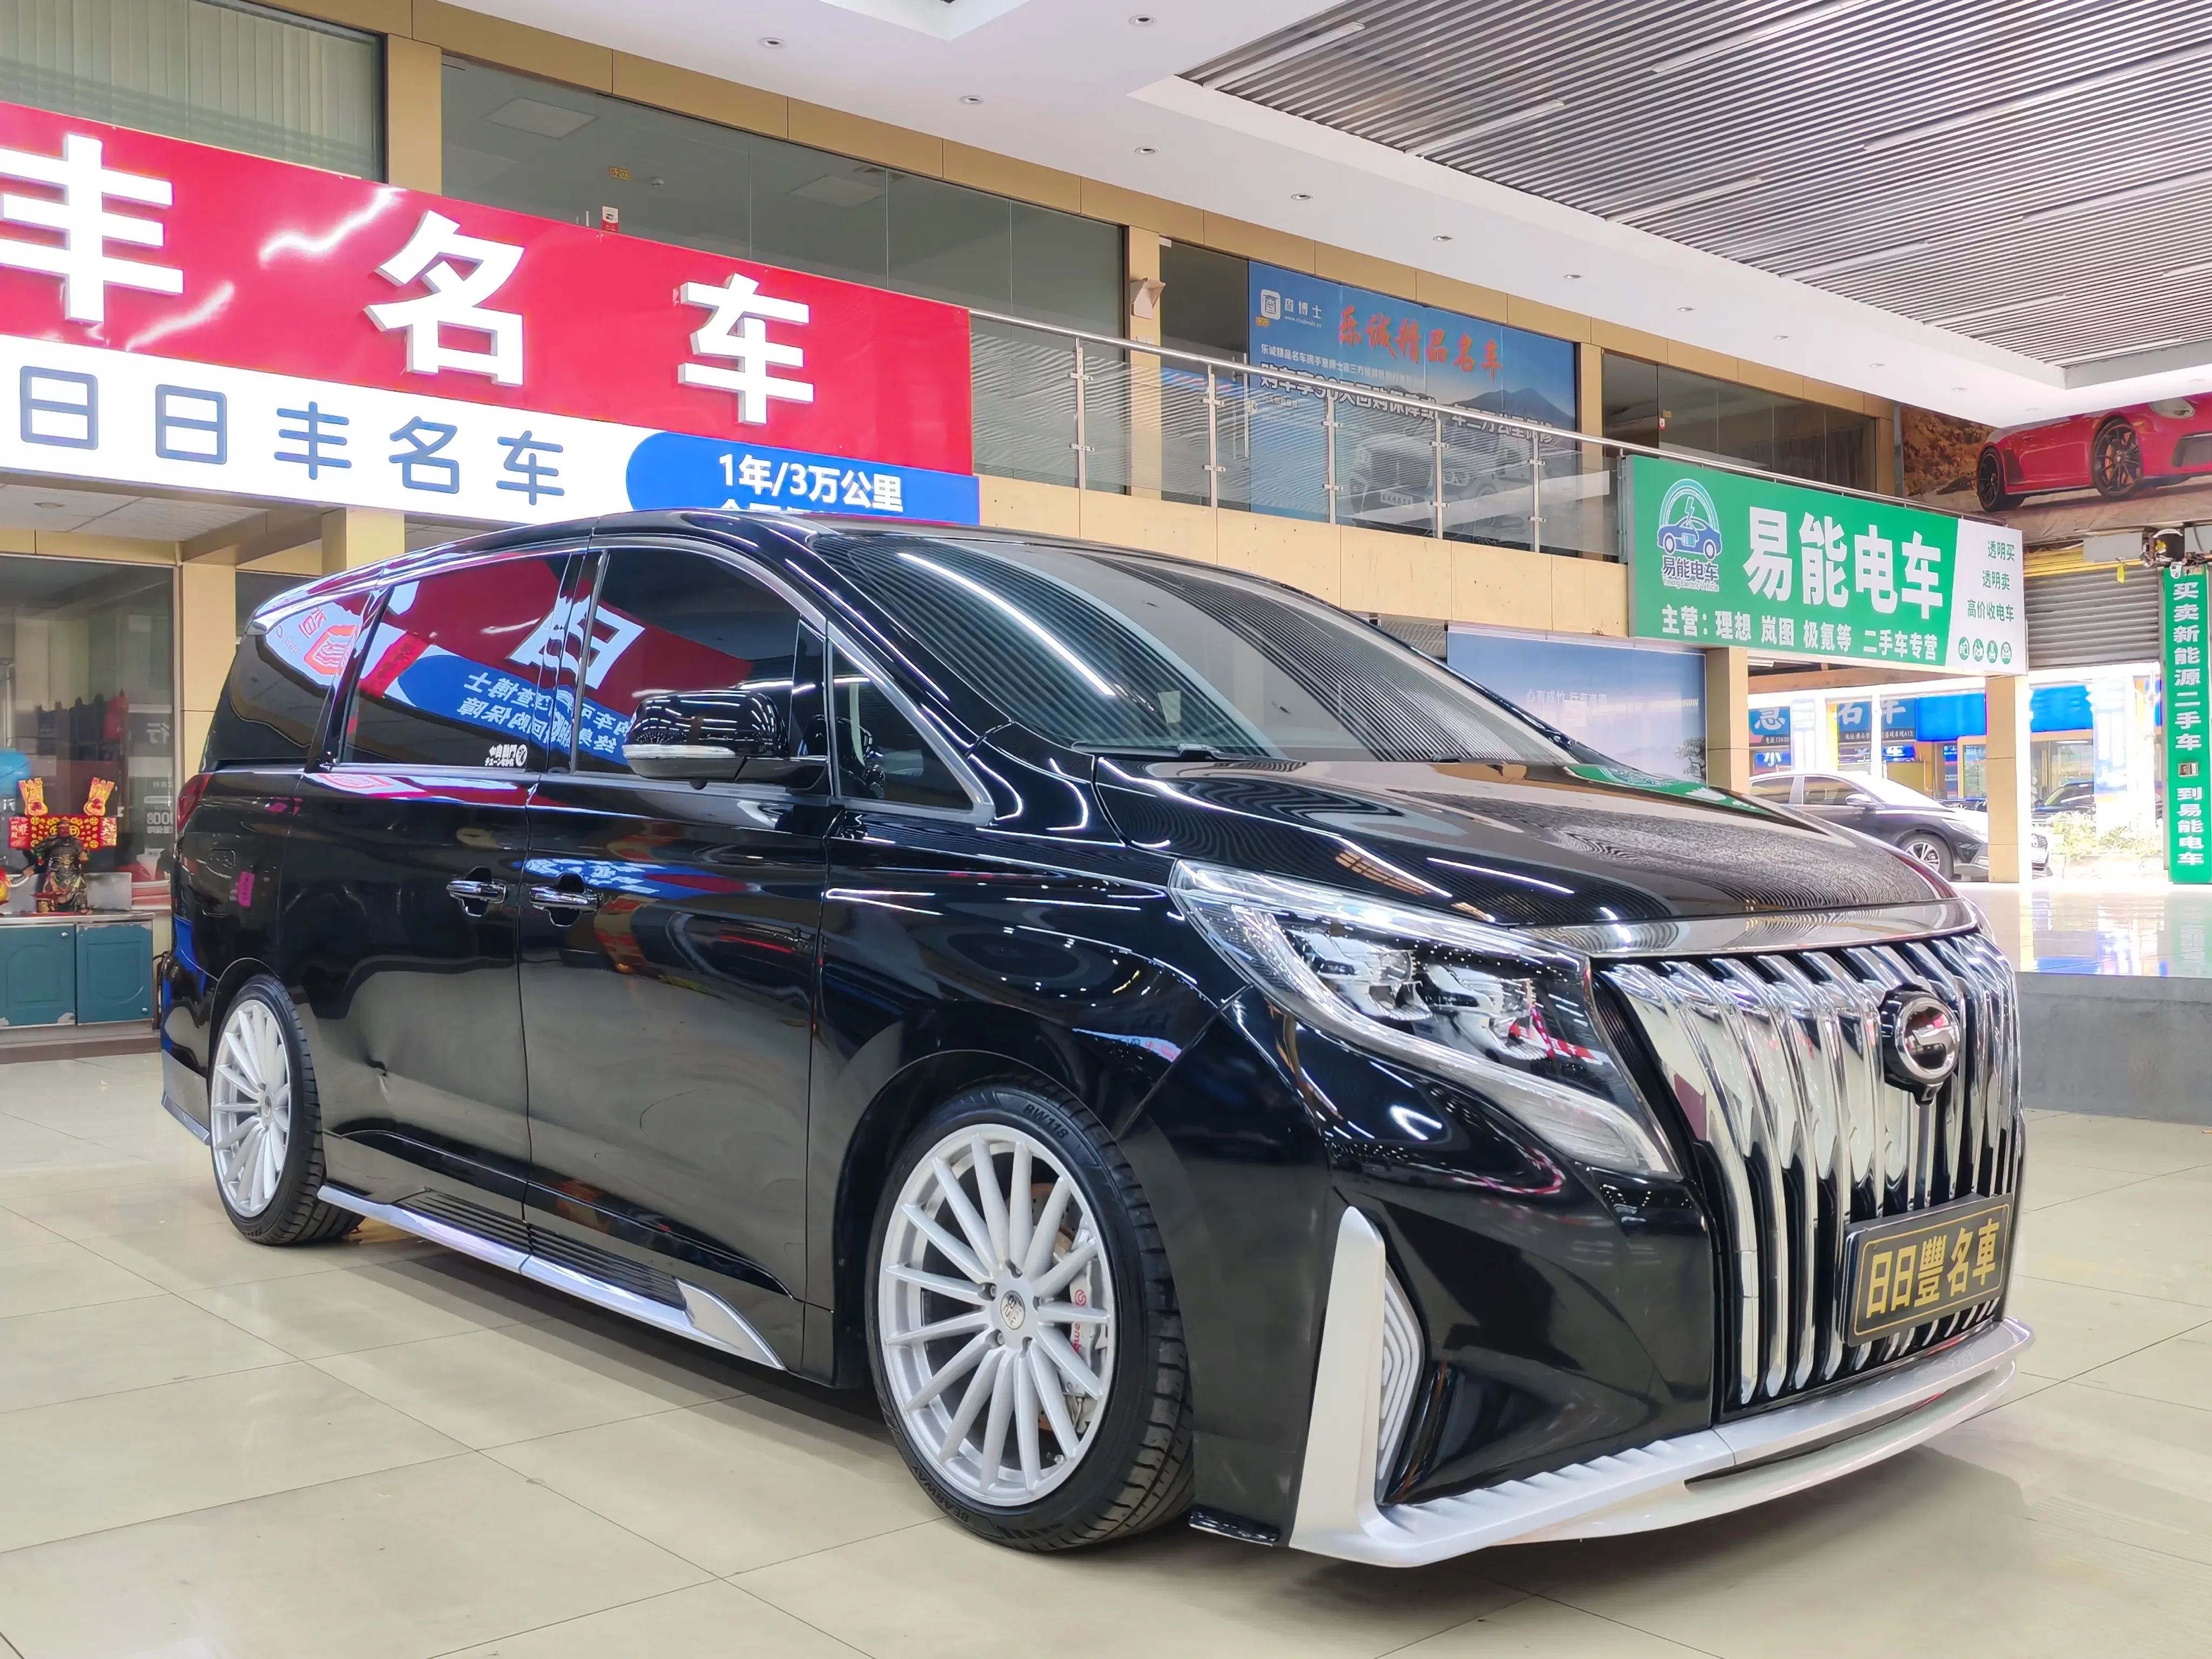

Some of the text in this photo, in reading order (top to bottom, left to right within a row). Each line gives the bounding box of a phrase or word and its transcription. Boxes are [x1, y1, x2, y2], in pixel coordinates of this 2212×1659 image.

[1284, 298, 1321, 319] 查博士
[1339, 305, 1503, 383] 乐诚精品名车
[19, 366, 565, 506] 日日丰名车
[719, 453, 903, 513] 1年/3万公里
[1662, 556, 1718, 582] 易能电车
[1743, 506, 1943, 620] 易能电车
[1982, 570, 2010, 591] 透明卖
[1987, 540, 2015, 562] 透明买
[1761, 614, 1795, 646] 岚图
[1803, 619, 1851, 652] 极氪等
[1863, 629, 1938, 662] 二手车专营
[1967, 598, 2014, 623] 高价收电车
[2173, 582, 2202, 752] 买卖新能源二手车
[2176, 785, 2205, 866] 到易能电车
[1023, 1103, 1070, 1140] BW118
[1865, 1217, 2001, 1319] 日日豐名車
[911, 1464, 970, 1524] BEARWAY
